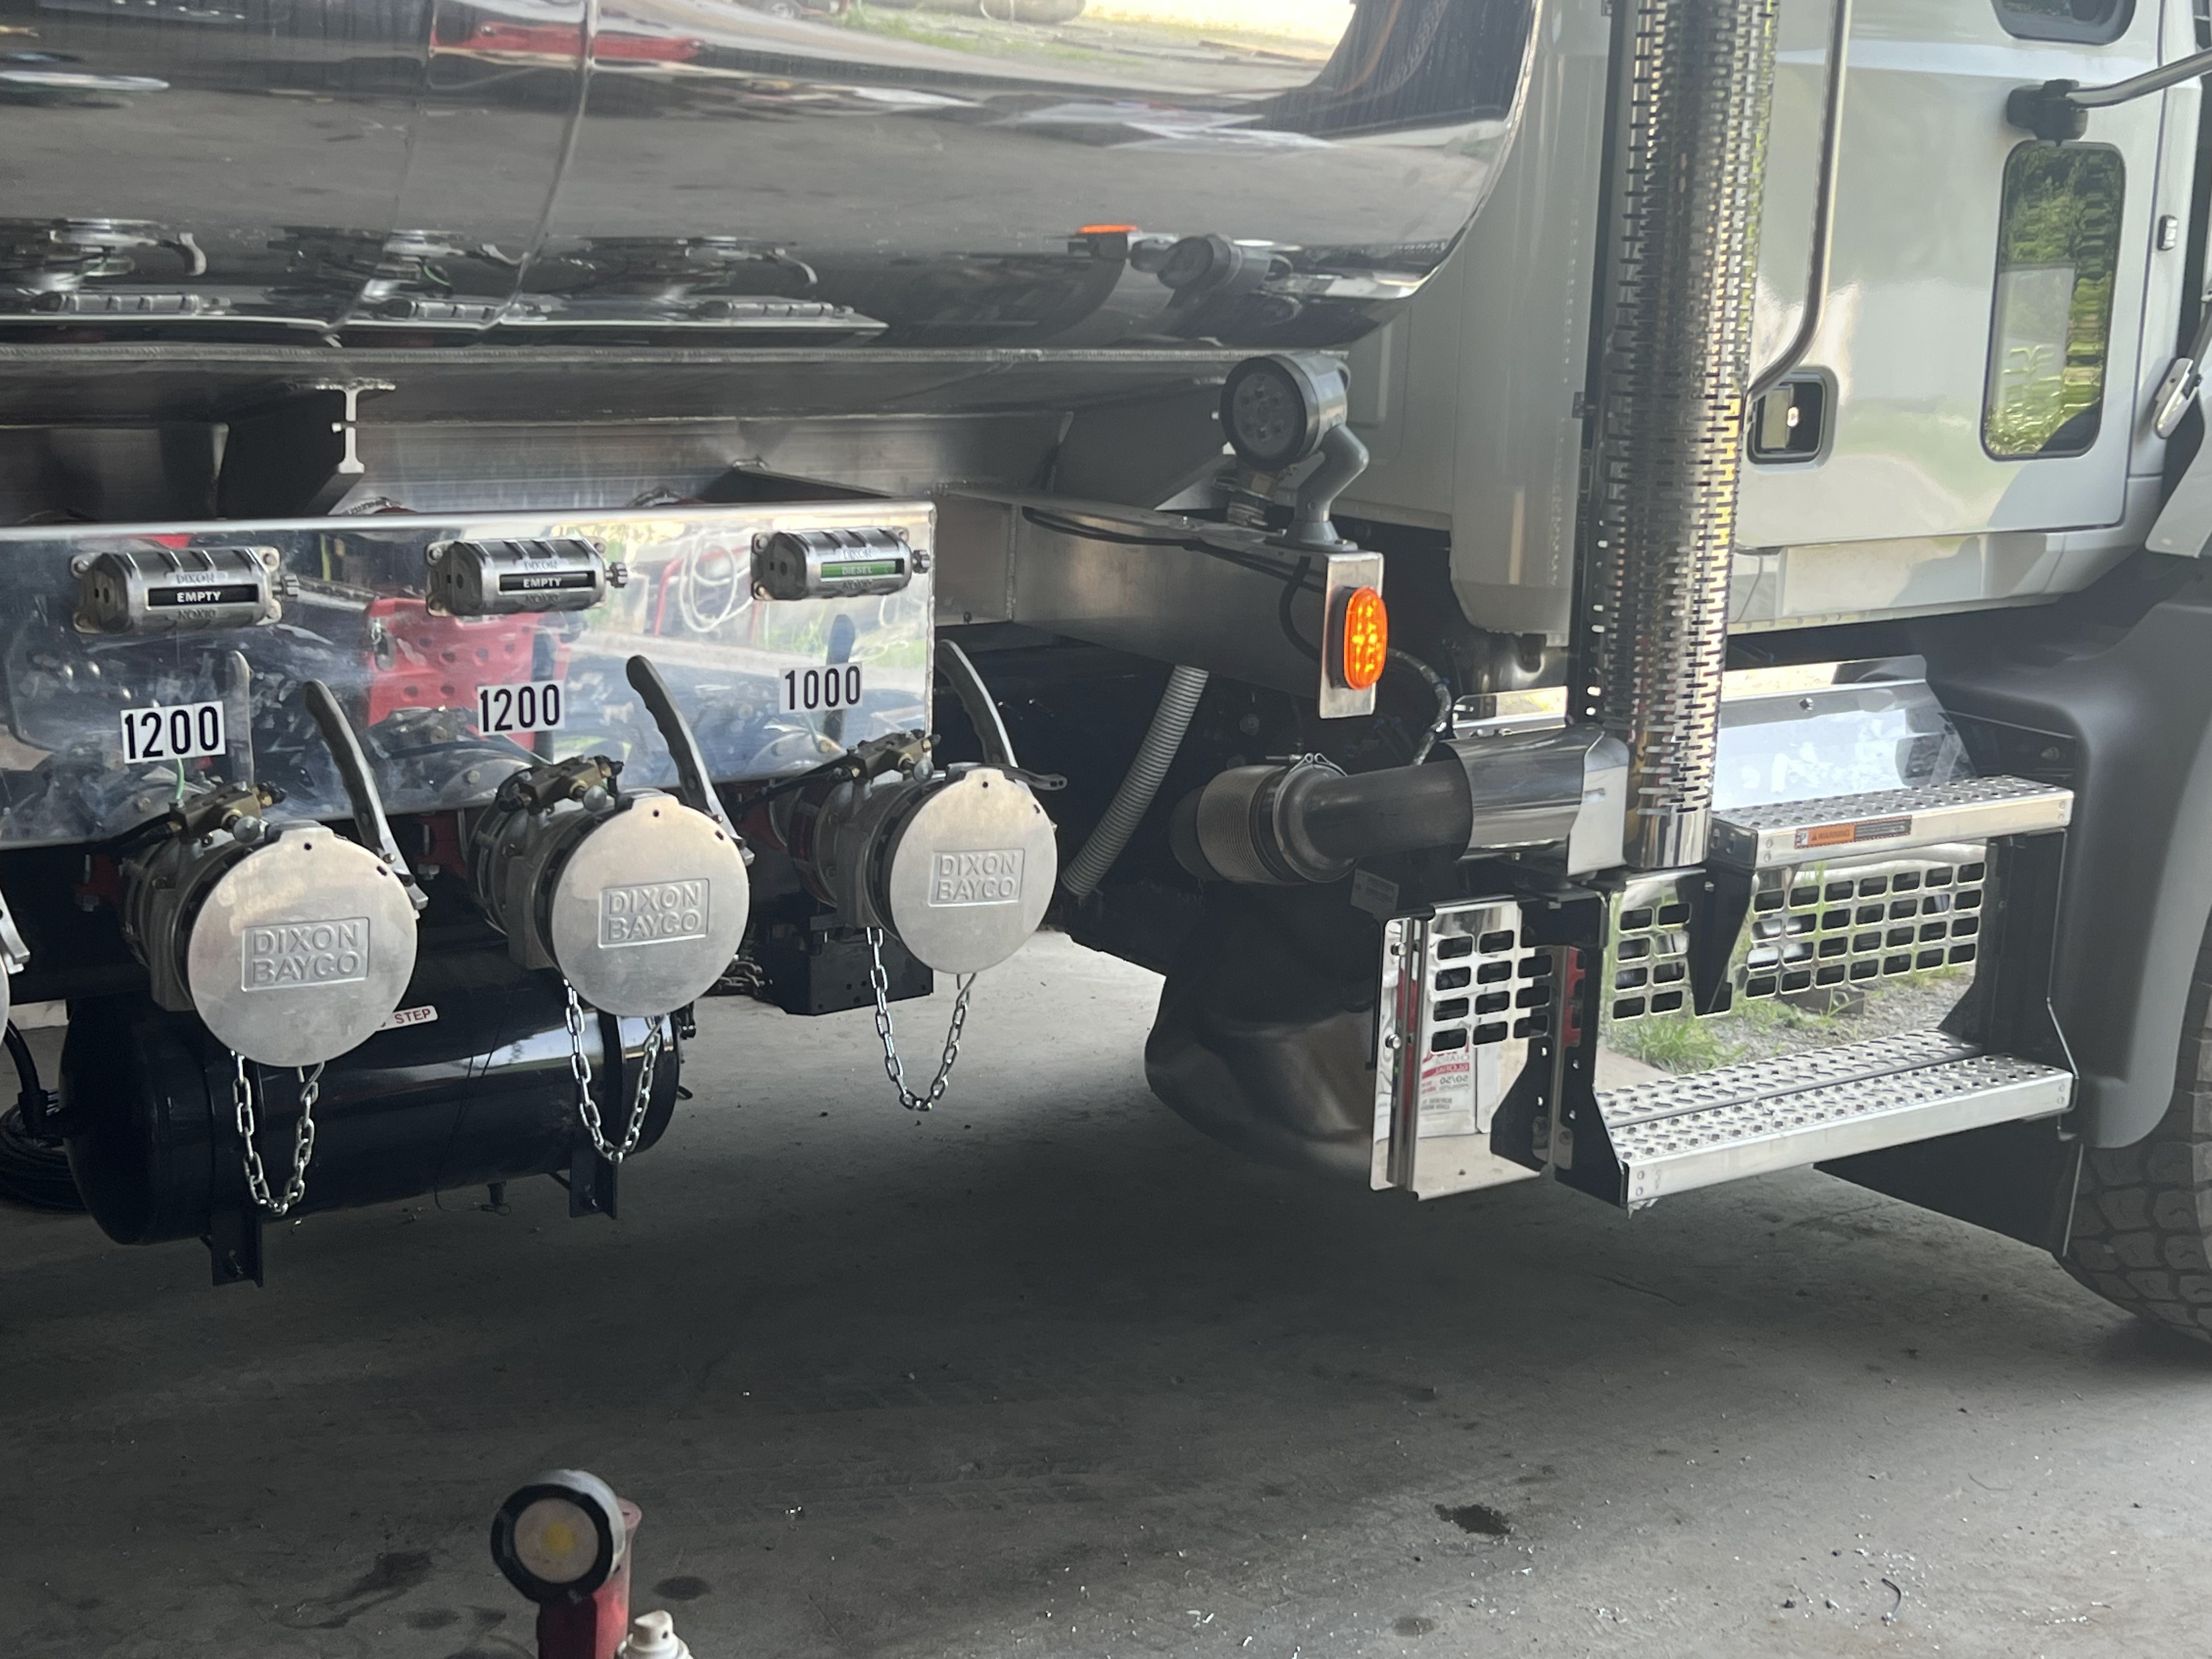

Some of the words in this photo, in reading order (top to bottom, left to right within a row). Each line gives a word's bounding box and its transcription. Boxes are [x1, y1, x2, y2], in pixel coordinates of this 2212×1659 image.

[176, 573, 215, 584] DIXON
[523, 578, 562, 589] EMPTY
[842, 566, 873, 575] DIESEL
[176, 591, 221, 603] EMPTY
[785, 665, 860, 710] 1000
[480, 684, 560, 732] 1200
[125, 706, 219, 759] 1200
[939, 853, 1017, 877] DIXON
[608, 882, 702, 915] DIXON
[936, 876, 1016, 901] BAYCO
[252, 922, 360, 956] DIXON
[607, 909, 702, 941] BAYCO
[252, 950, 360, 984] BAYCO
[394, 1008, 431, 1024] STEP
